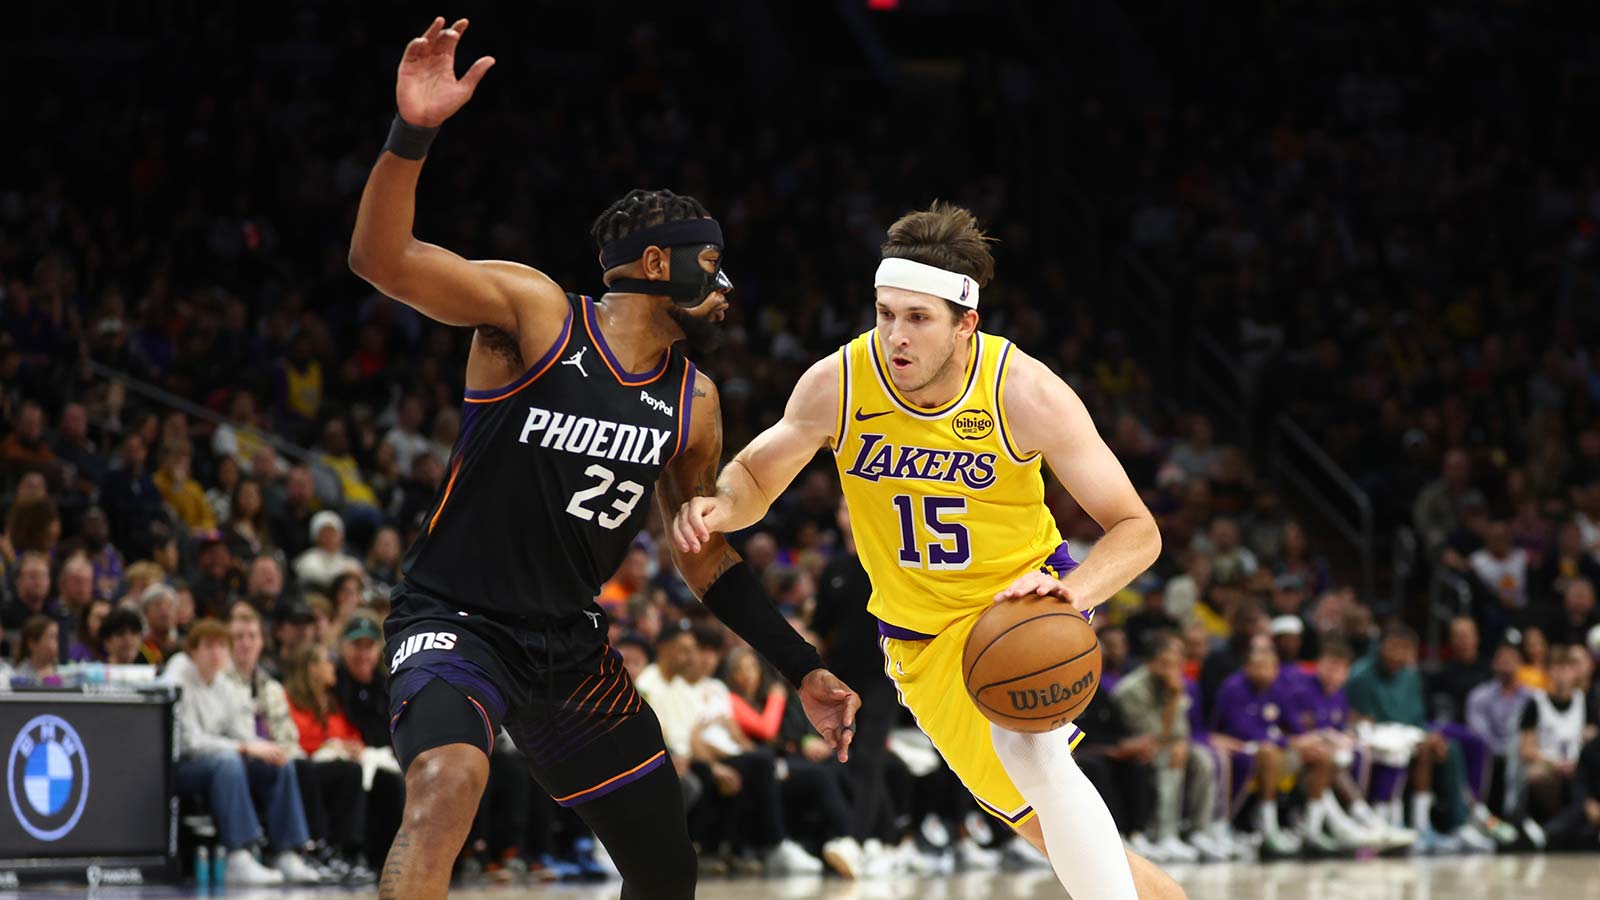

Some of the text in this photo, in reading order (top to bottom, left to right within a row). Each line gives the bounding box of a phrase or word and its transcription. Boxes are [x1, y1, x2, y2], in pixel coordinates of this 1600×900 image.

[640, 390, 673, 417] PayPal
[956, 417, 992, 431] bibigo
[518, 407, 672, 466] PHOENIX
[846, 433, 998, 490] LAKERS
[565, 464, 645, 530] 23
[892, 494, 973, 571] 15
[1007, 671, 1095, 712] Wilson
